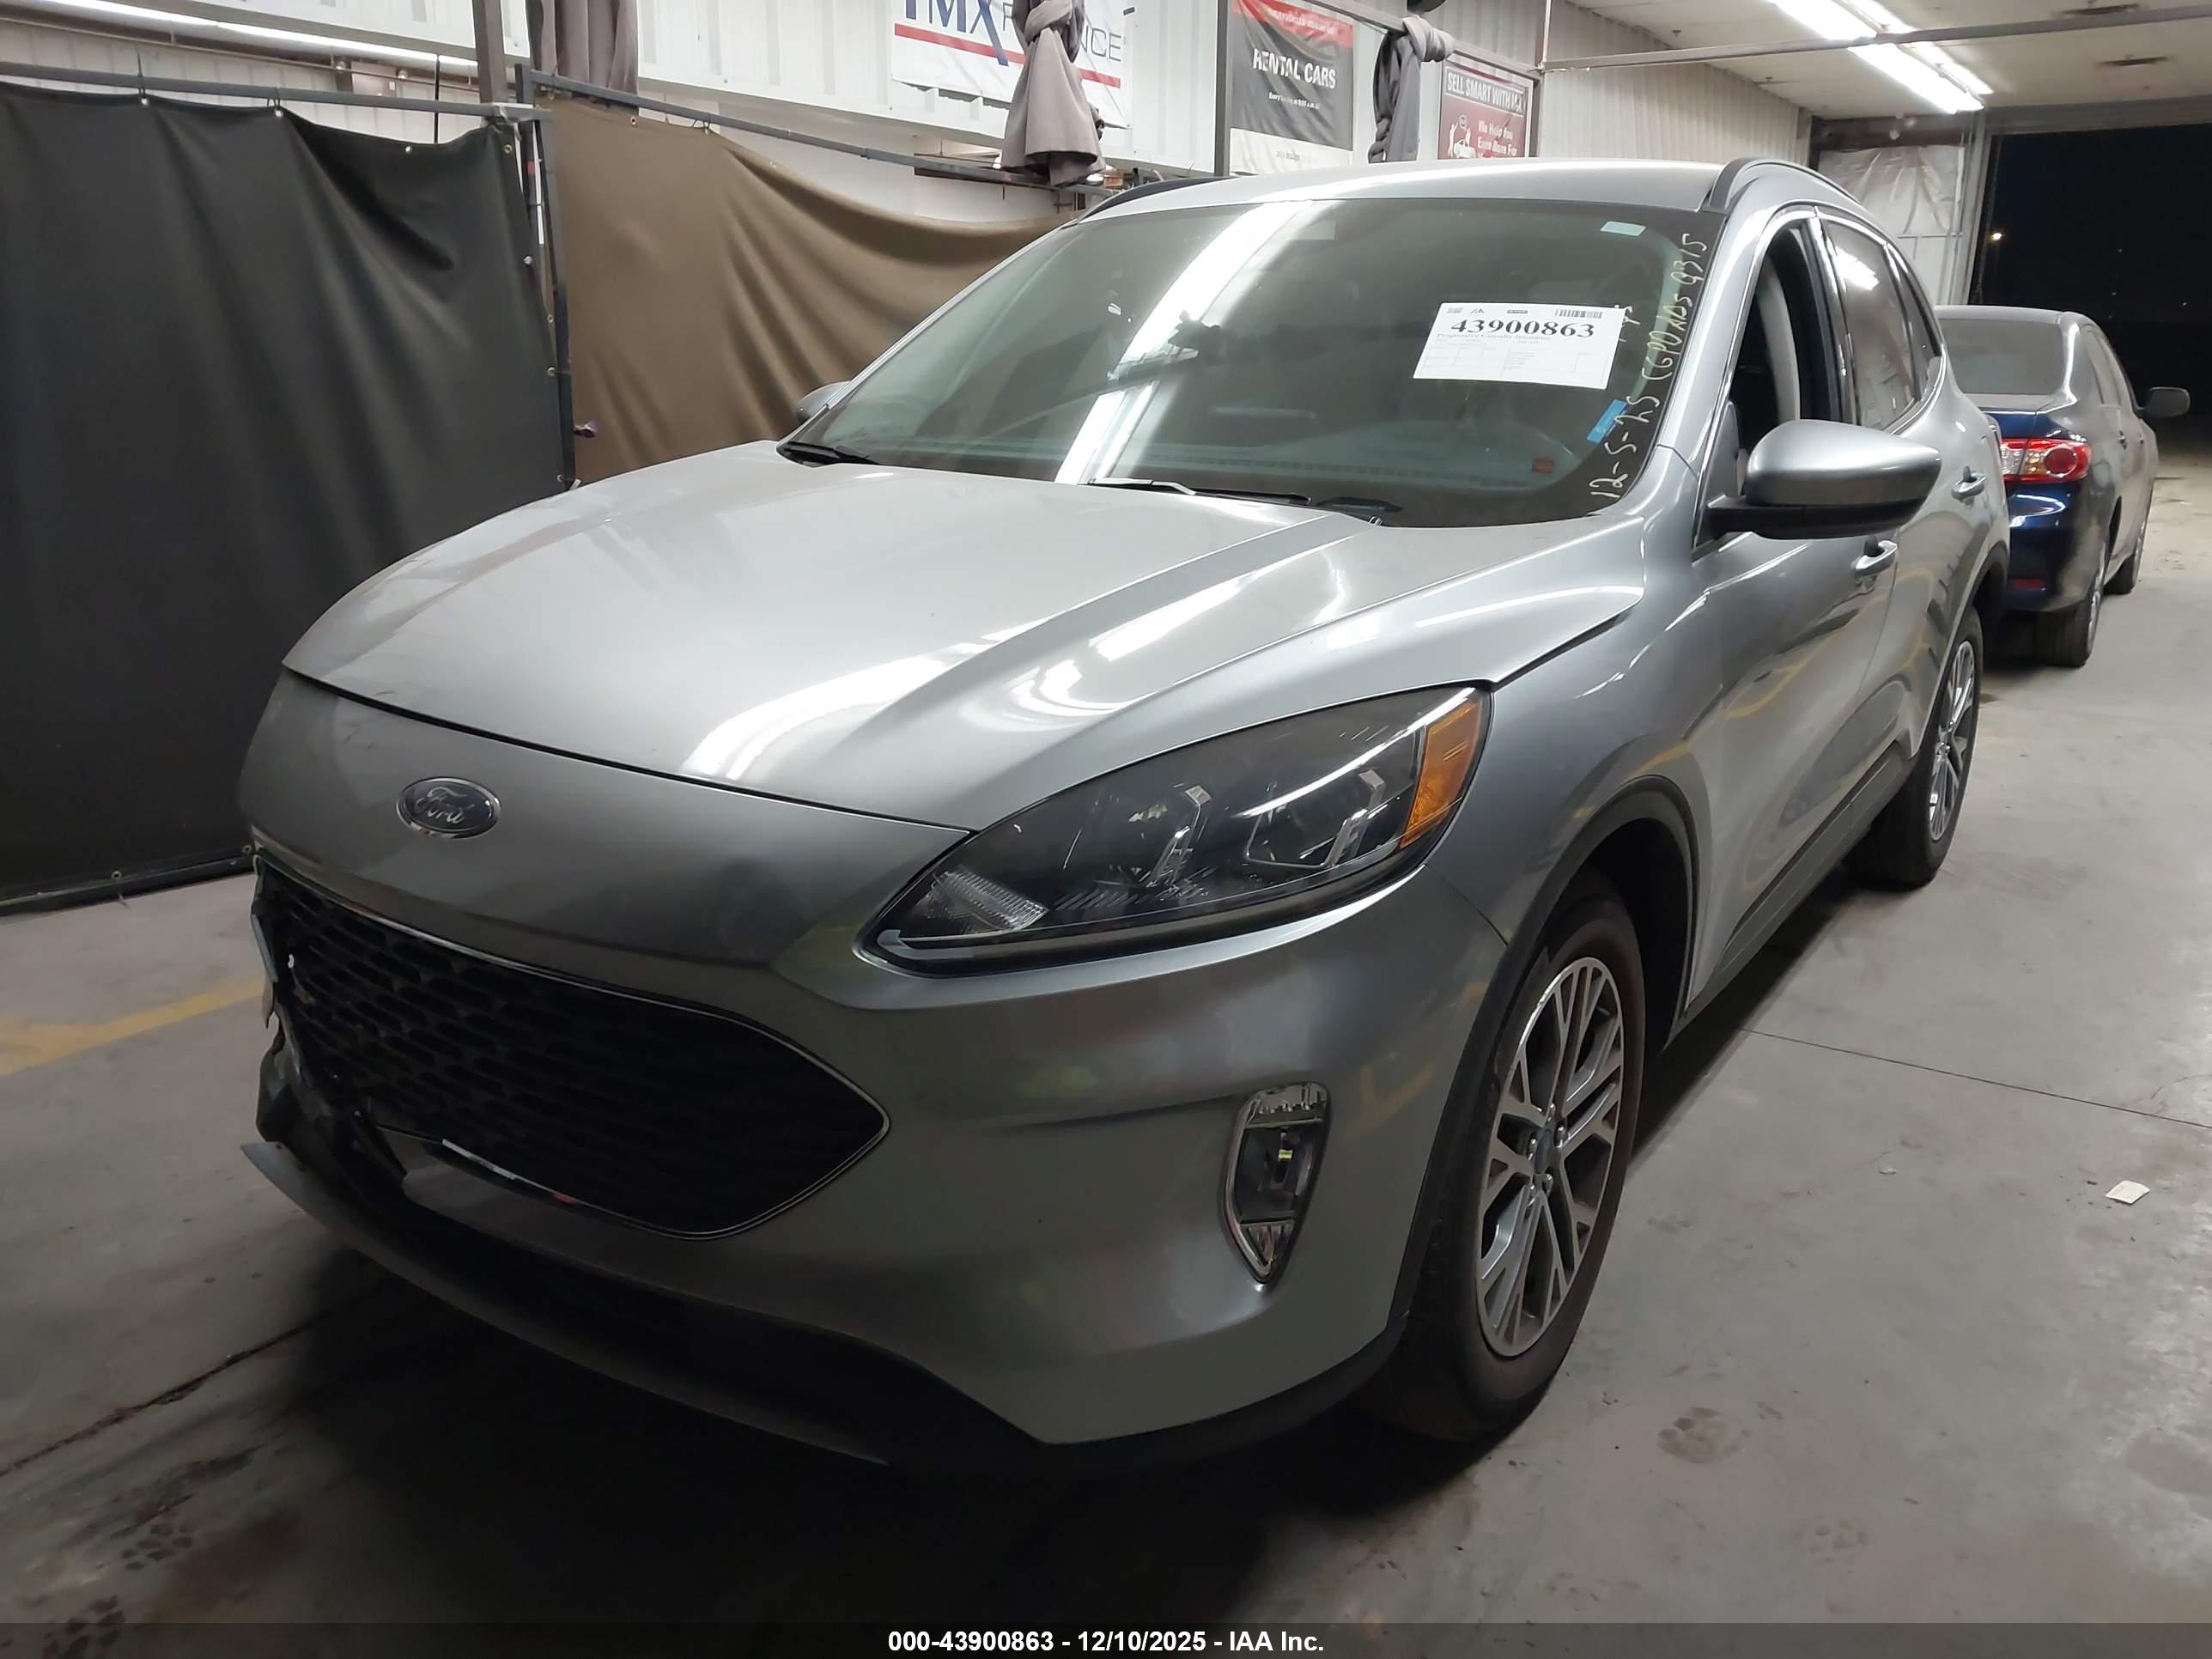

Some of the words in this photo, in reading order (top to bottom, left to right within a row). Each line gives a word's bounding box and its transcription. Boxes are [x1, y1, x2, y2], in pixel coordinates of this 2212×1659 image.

[1253, 47, 1301, 80] RENTAL
[1304, 62, 1336, 89] CARS
[1447, 72, 1465, 94] SELL
[1465, 78, 1492, 103] SMART
[1492, 87, 1511, 109] WITH
[1451, 319, 1595, 338] 43900863
[414, 787, 475, 824] Ford
